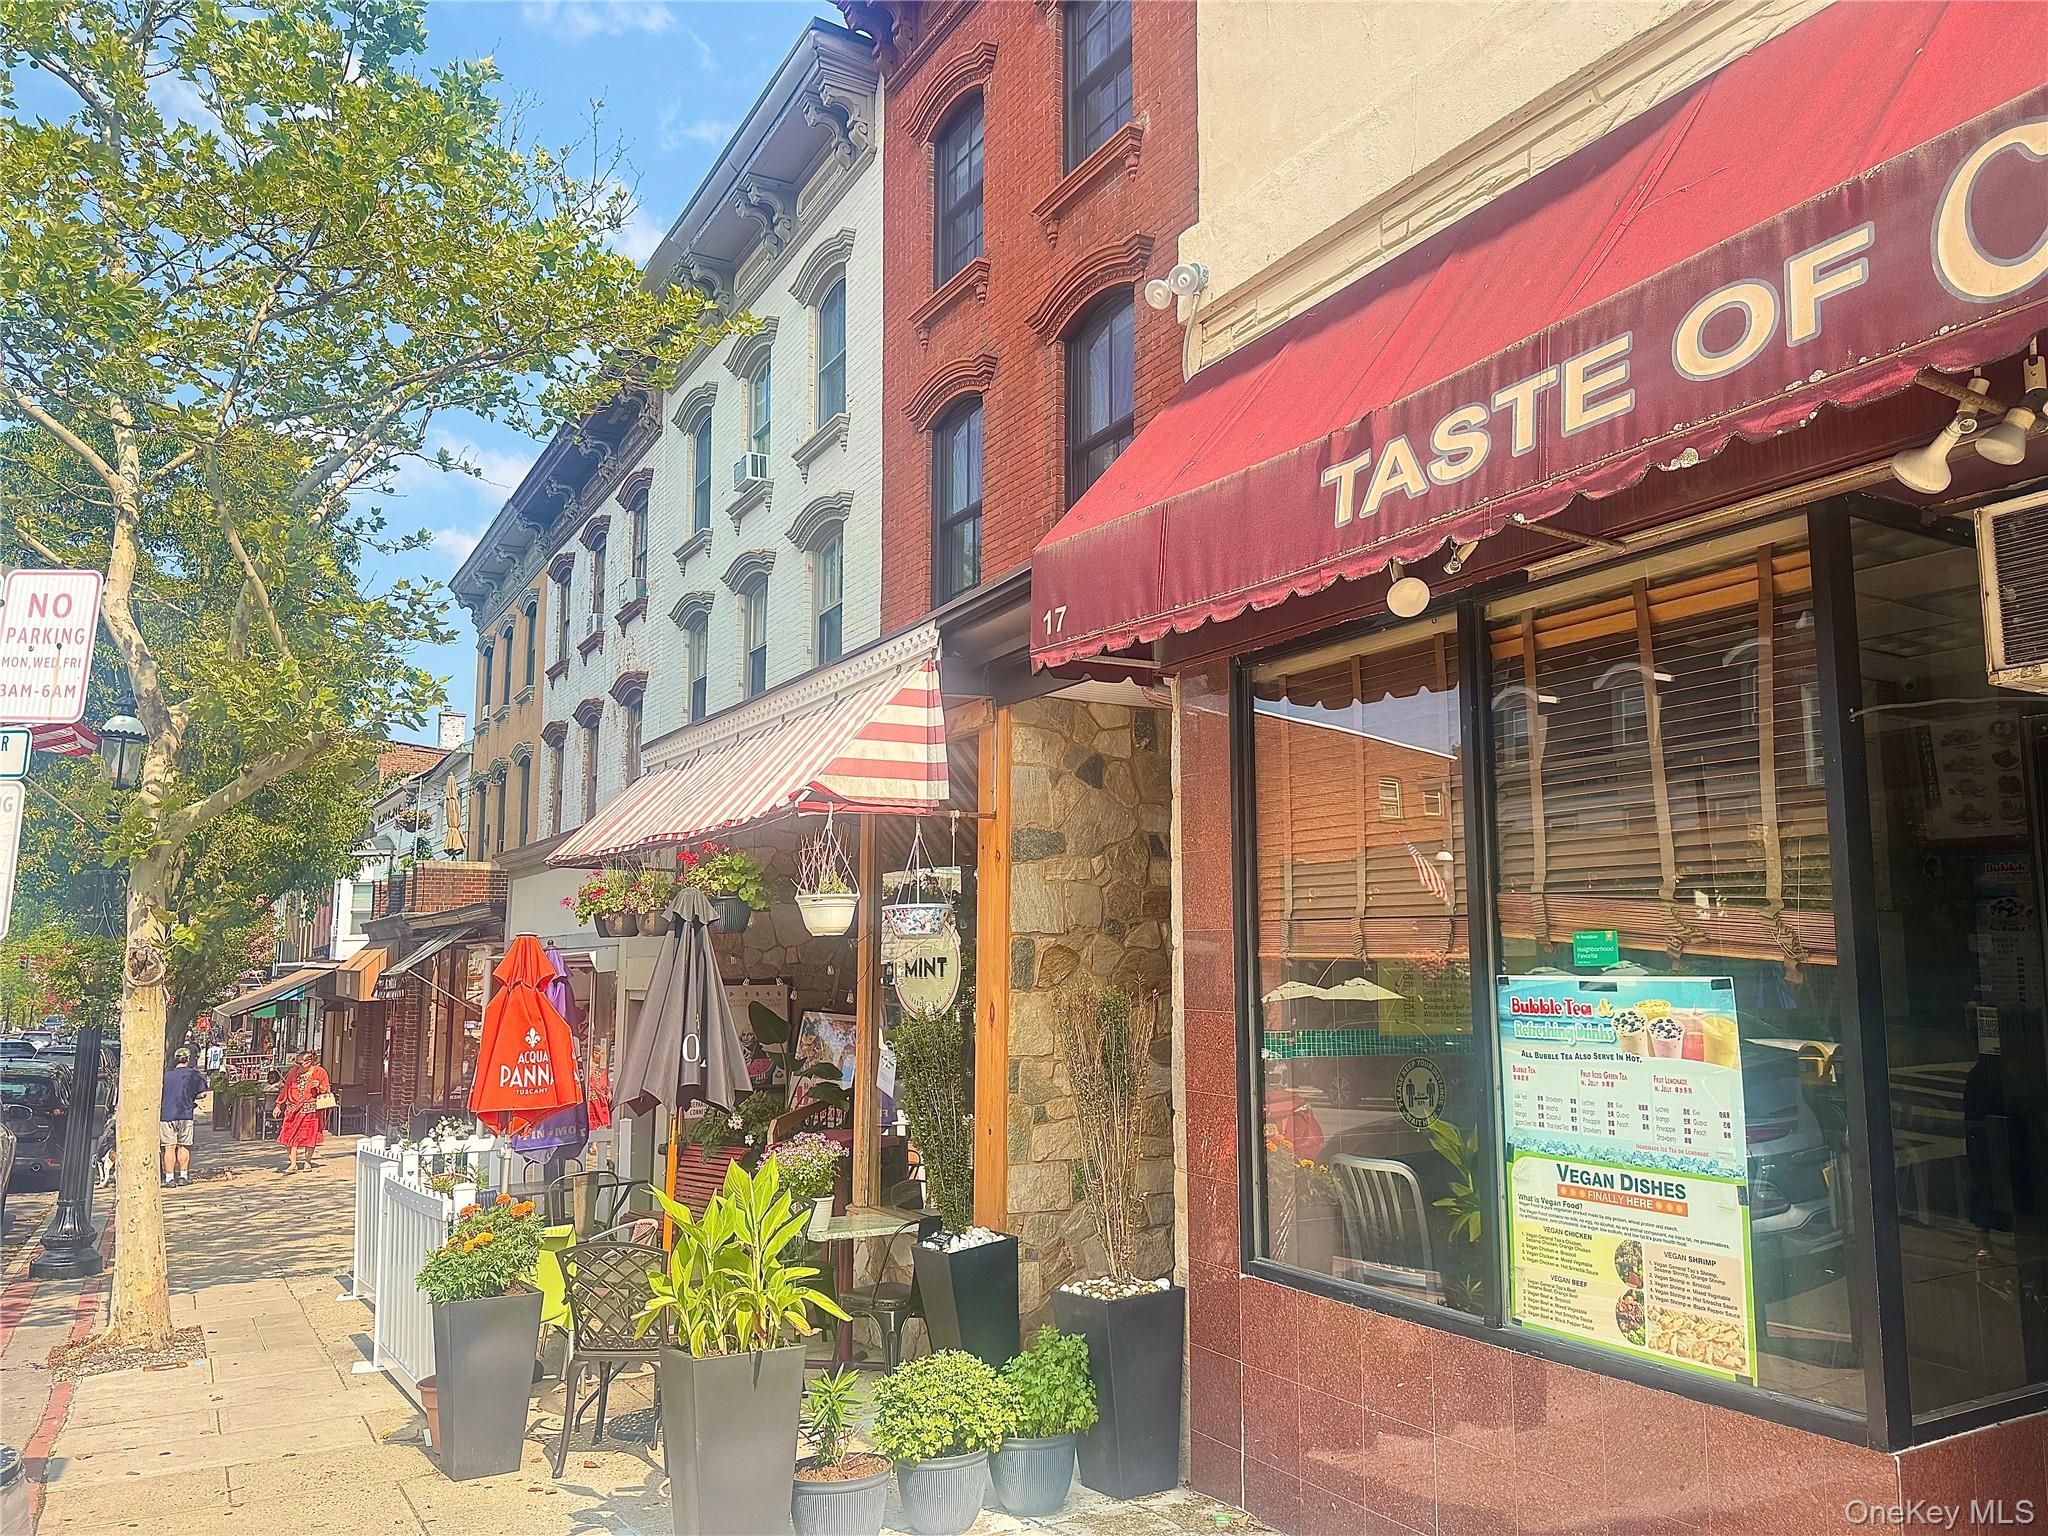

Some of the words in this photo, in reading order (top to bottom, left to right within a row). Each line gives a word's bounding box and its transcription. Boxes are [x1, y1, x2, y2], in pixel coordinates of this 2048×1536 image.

[1322, 332, 1635, 529] TASTE
[1673, 222, 1875, 383] OF
[28, 593, 73, 618] NO
[1042, 605, 1067, 635] 17
[6, 627, 85, 645] PARKING
[904, 956, 947, 979] MINT
[1512, 998, 1562, 1014] Bubble
[1565, 999, 1592, 1015] Tea
[1598, 1000, 1614, 1016] &
[1515, 1021, 1575, 1044] Refreshing
[1576, 1024, 1615, 1042] Drinks
[518, 1050, 549, 1064] ACQUA
[1521, 1050, 1533, 1058] ALL
[1534, 1051, 1559, 1059] BUBBLE
[1561, 1052, 1573, 1060] TEA
[1575, 1052, 1591, 1061] ALSO
[1593, 1053, 1614, 1062] SERVE
[1616, 1054, 1624, 1062] IN
[1592, 1070, 1602, 1079] ICED
[1603, 1071, 1619, 1080] GREEN
[1619, 1072, 1627, 1081] TEA
[1653, 1075, 1664, 1084] FRUIT
[1665, 1076, 1688, 1085] LEMONADE
[1557, 1164, 1614, 1189] VEGAN
[1620, 1172, 1686, 1200] DISHES
[1518, 1194, 1533, 1202] What
[1541, 1197, 1561, 1208] Vegan
[1563, 1200, 1583, 1210] Food?
[1588, 1191, 1624, 1204] FINALLY
[1627, 1196, 1653, 1209] HERE
[1543, 1226, 1564, 1236] VEGAN
[1564, 1230, 1592, 1241] CHICKEN
[1664, 1251, 1687, 1262] VEGAN
[1689, 1256, 1717, 1267] SHRIMP
[1551, 1274, 1570, 1284] VEGAN
[1572, 1279, 1588, 1288] BEEF
